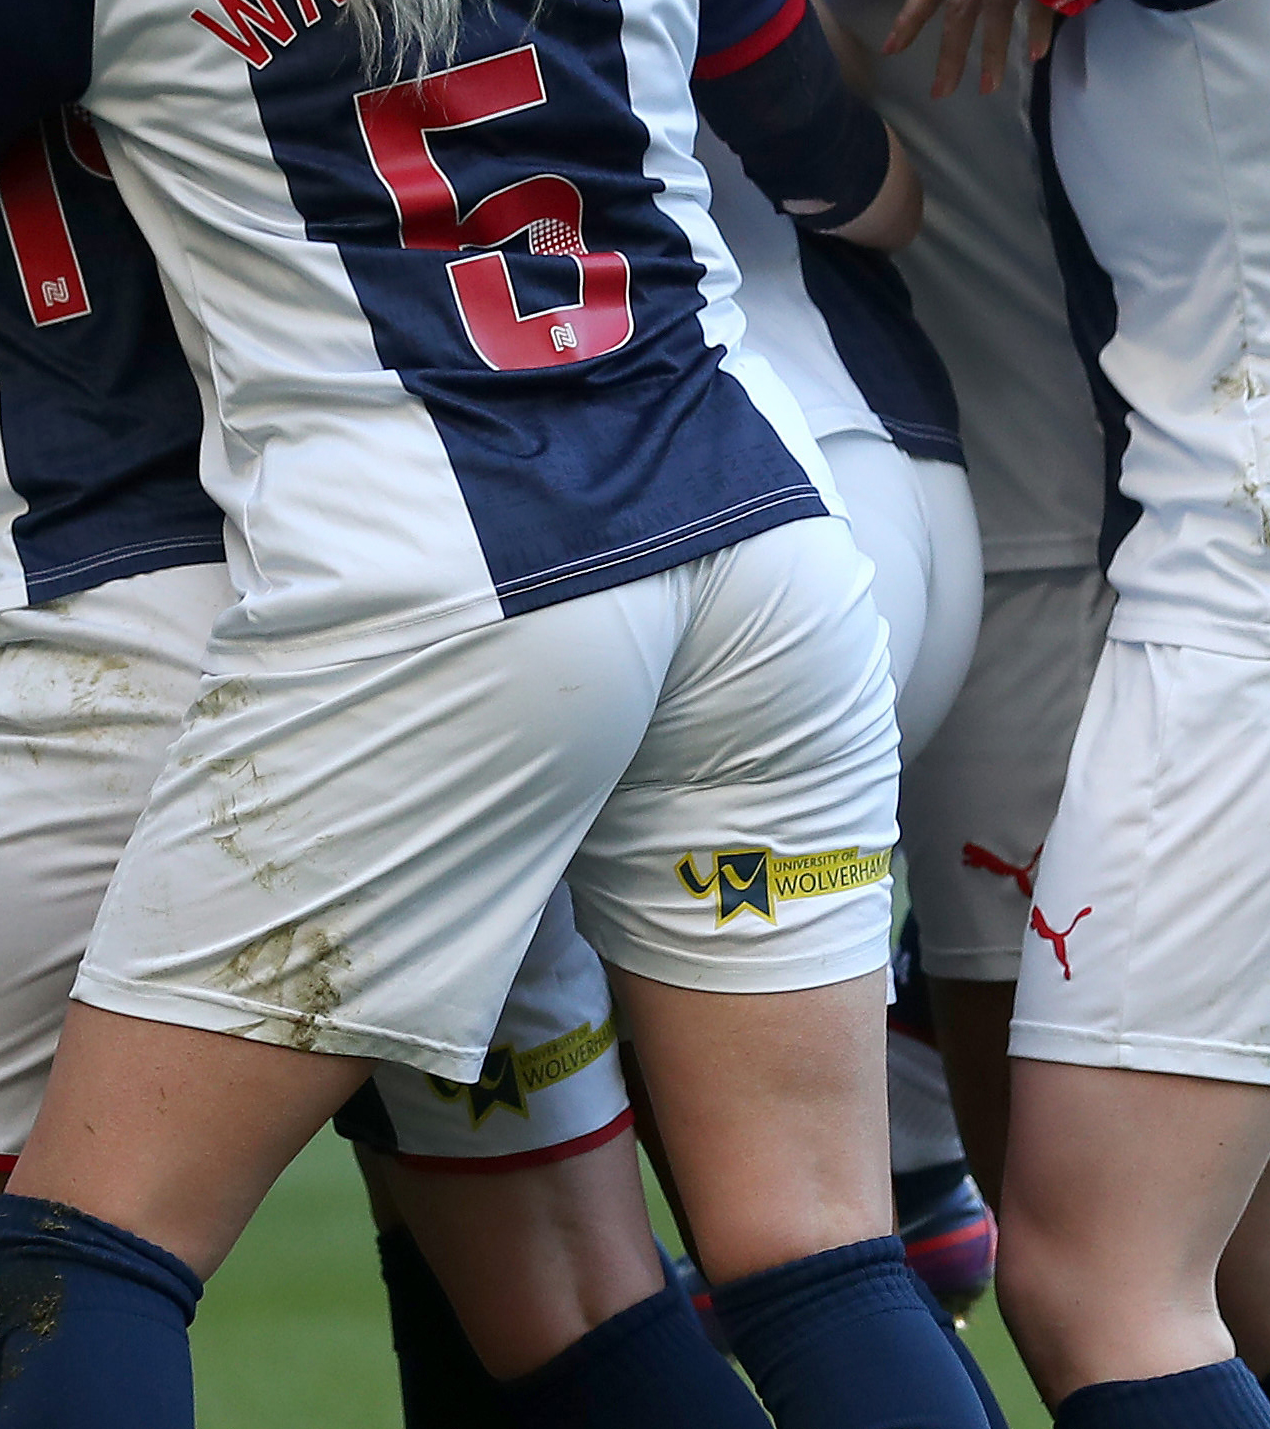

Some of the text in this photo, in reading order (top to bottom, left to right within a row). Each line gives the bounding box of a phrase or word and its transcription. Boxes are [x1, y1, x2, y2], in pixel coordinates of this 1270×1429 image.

[353, 42, 635, 372] 5
[773, 850, 856, 873] UNIVERSITY OF
